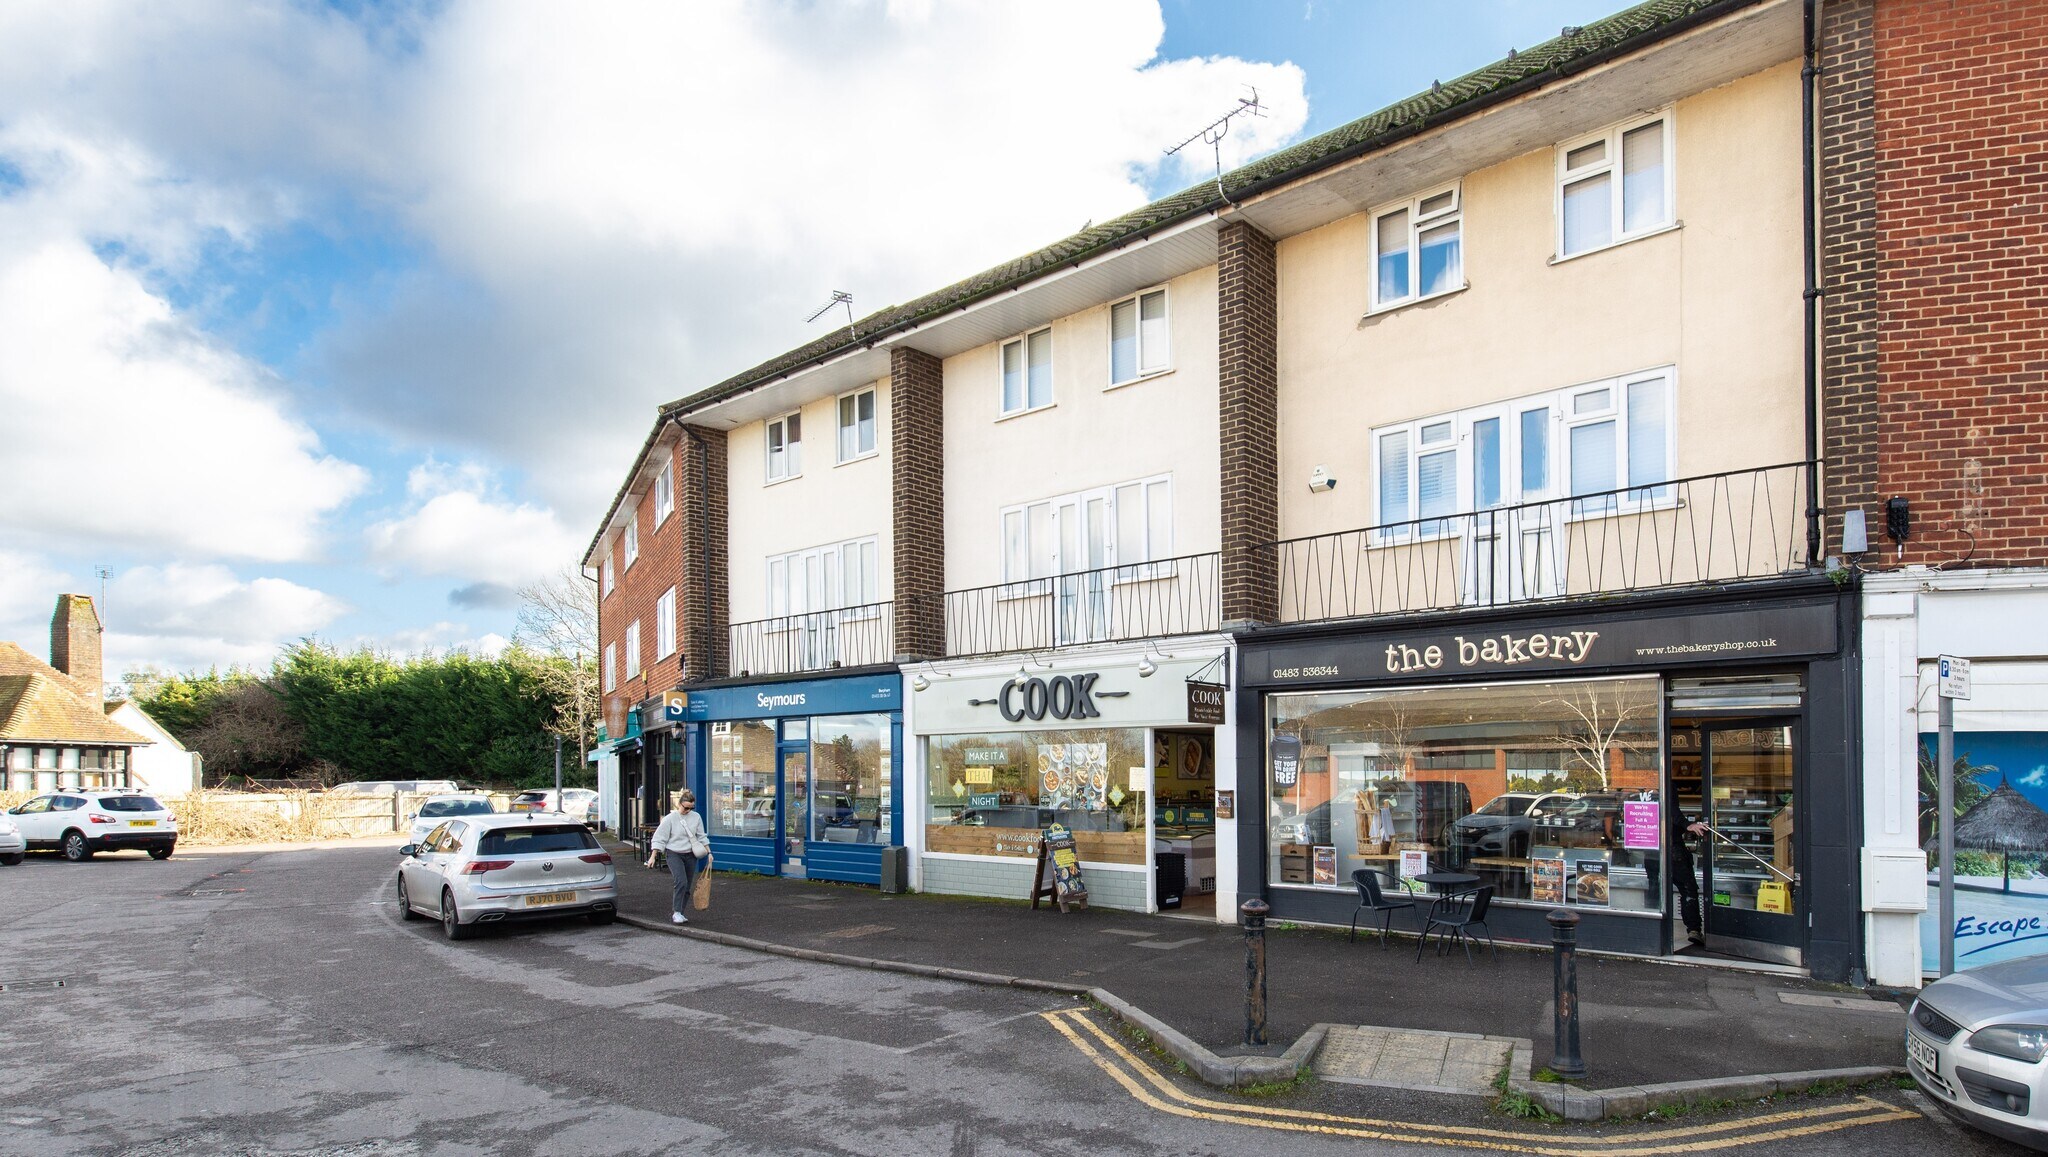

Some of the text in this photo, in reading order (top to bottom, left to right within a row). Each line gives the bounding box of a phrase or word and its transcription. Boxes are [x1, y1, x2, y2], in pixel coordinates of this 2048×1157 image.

[1385, 632, 1600, 673] the bakery
[1636, 638, 1777, 656] www.thebakeryshop.co.uk
[1273, 668, 1299, 678] 01483
[758, 692, 806, 710] Seymours
[999, 672, 1100, 722] COOK
[1192, 690, 1222, 705] COOK
[670, 698, 683, 715] S
[969, 752, 1005, 760] MAKE IT A
[968, 770, 990, 781] THAI
[1275, 771, 1296, 784] FREE
[972, 797, 996, 806] NIGHT
[529, 892, 572, 904] RJ70 BVU
[1954, 916, 2040, 938] Escape
